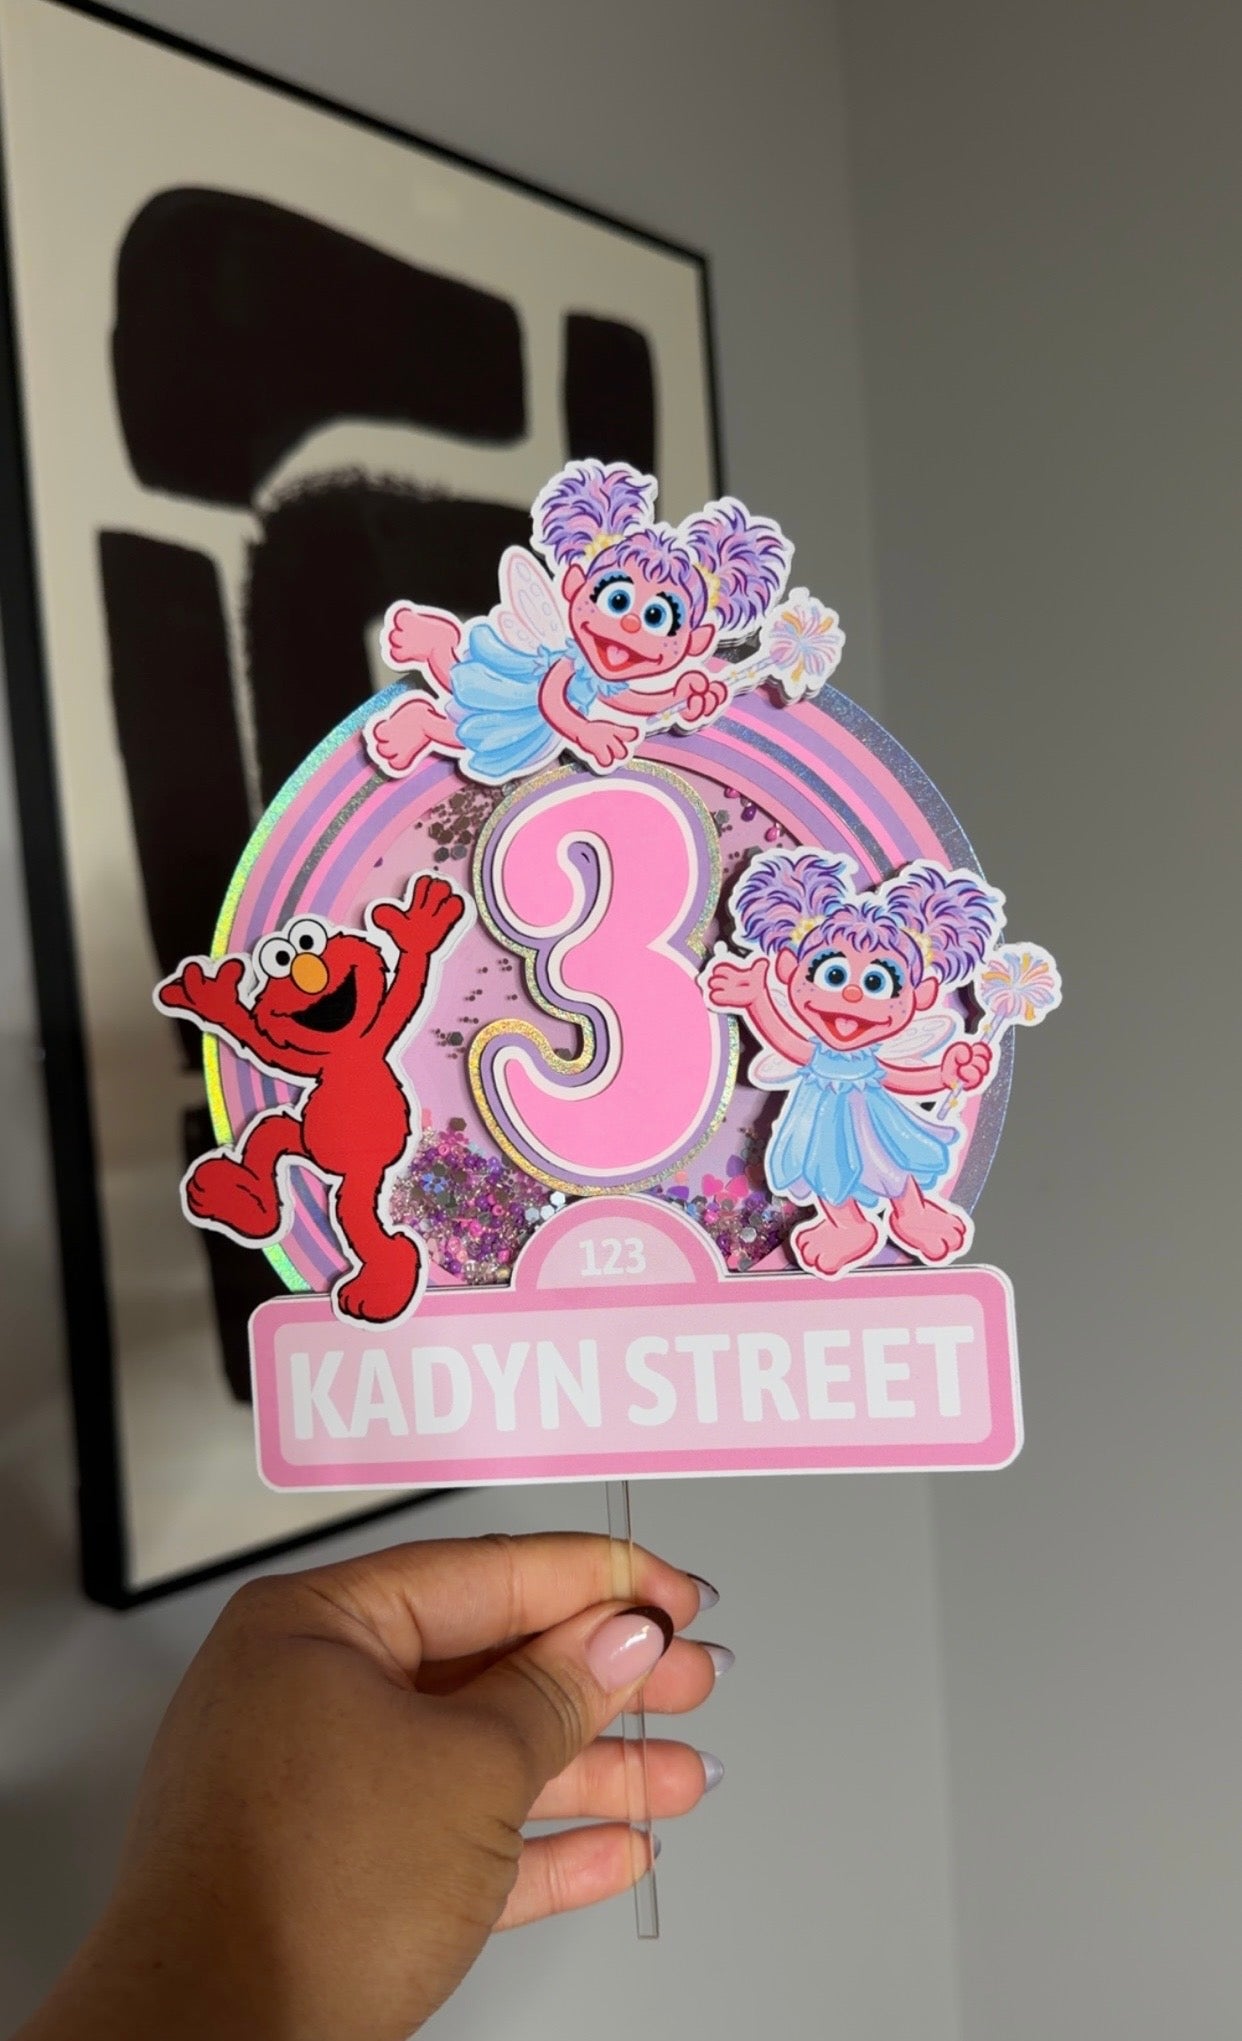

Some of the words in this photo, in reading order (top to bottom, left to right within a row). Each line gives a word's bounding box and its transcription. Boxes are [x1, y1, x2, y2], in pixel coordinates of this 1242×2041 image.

[488, 775, 724, 1180] 3
[578, 1237, 646, 1277] 123
[290, 1338, 602, 1440] KADYN
[625, 1326, 974, 1427] STREET
